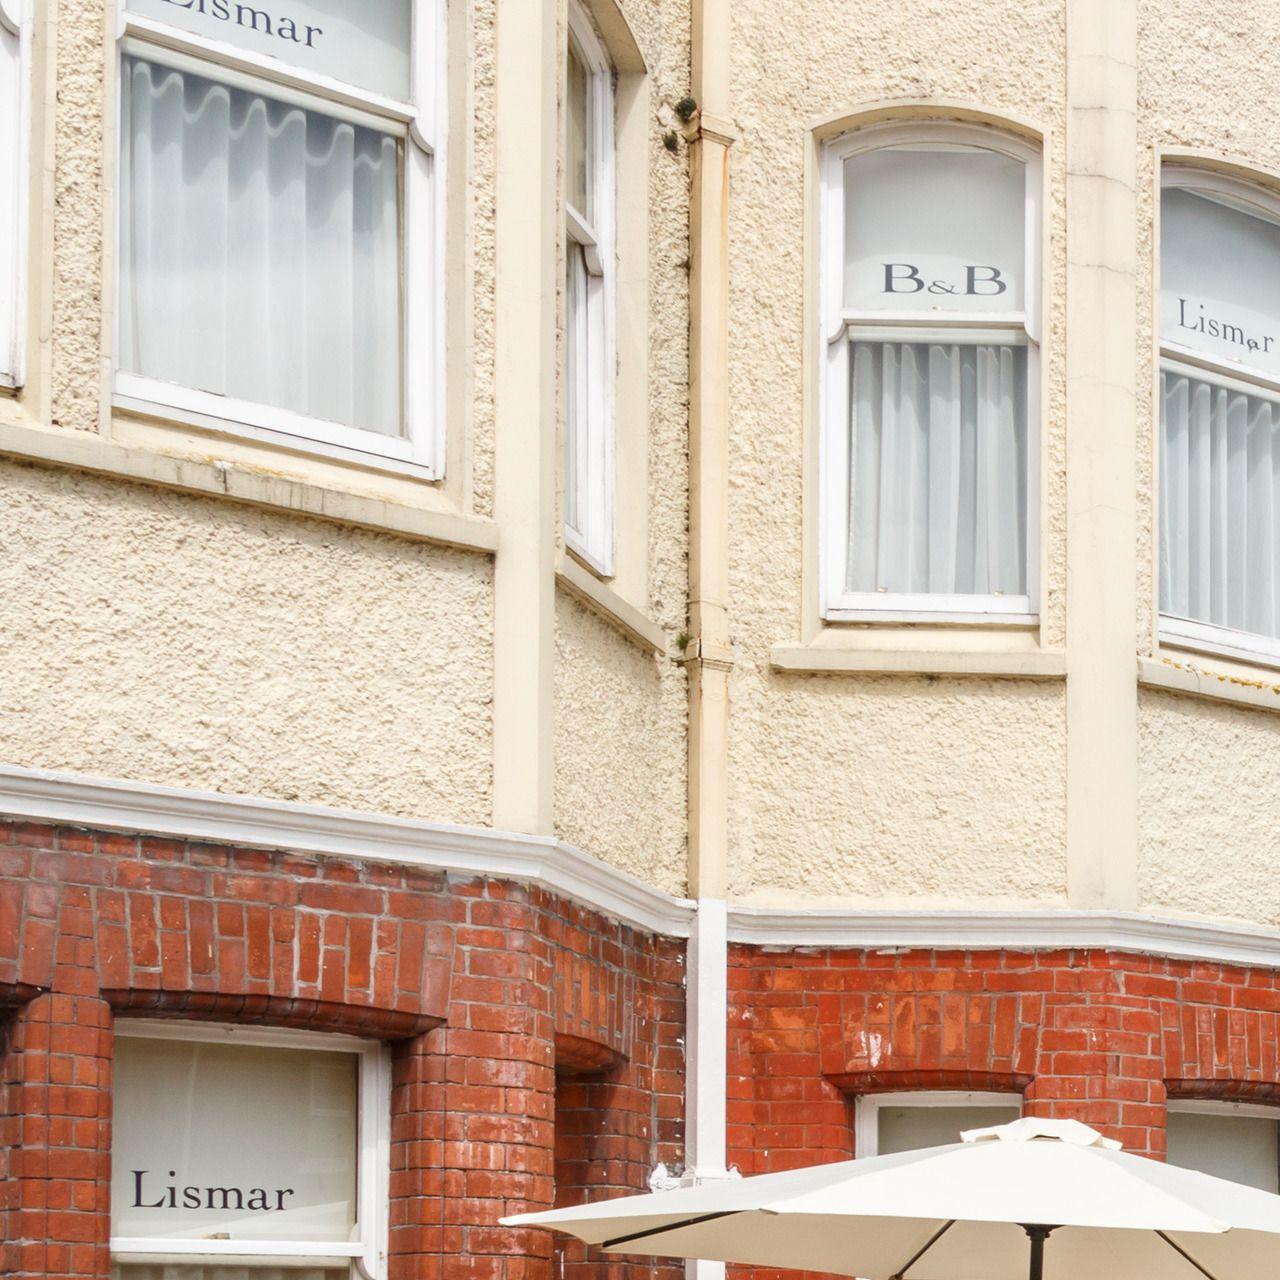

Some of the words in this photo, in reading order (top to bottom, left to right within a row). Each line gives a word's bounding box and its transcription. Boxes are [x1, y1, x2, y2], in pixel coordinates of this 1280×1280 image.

[161, 0, 324, 48] smar
[881, 263, 1007, 296] B&B
[1178, 298, 1275, 353] Lismar
[130, 1170, 296, 1211] Lismar
